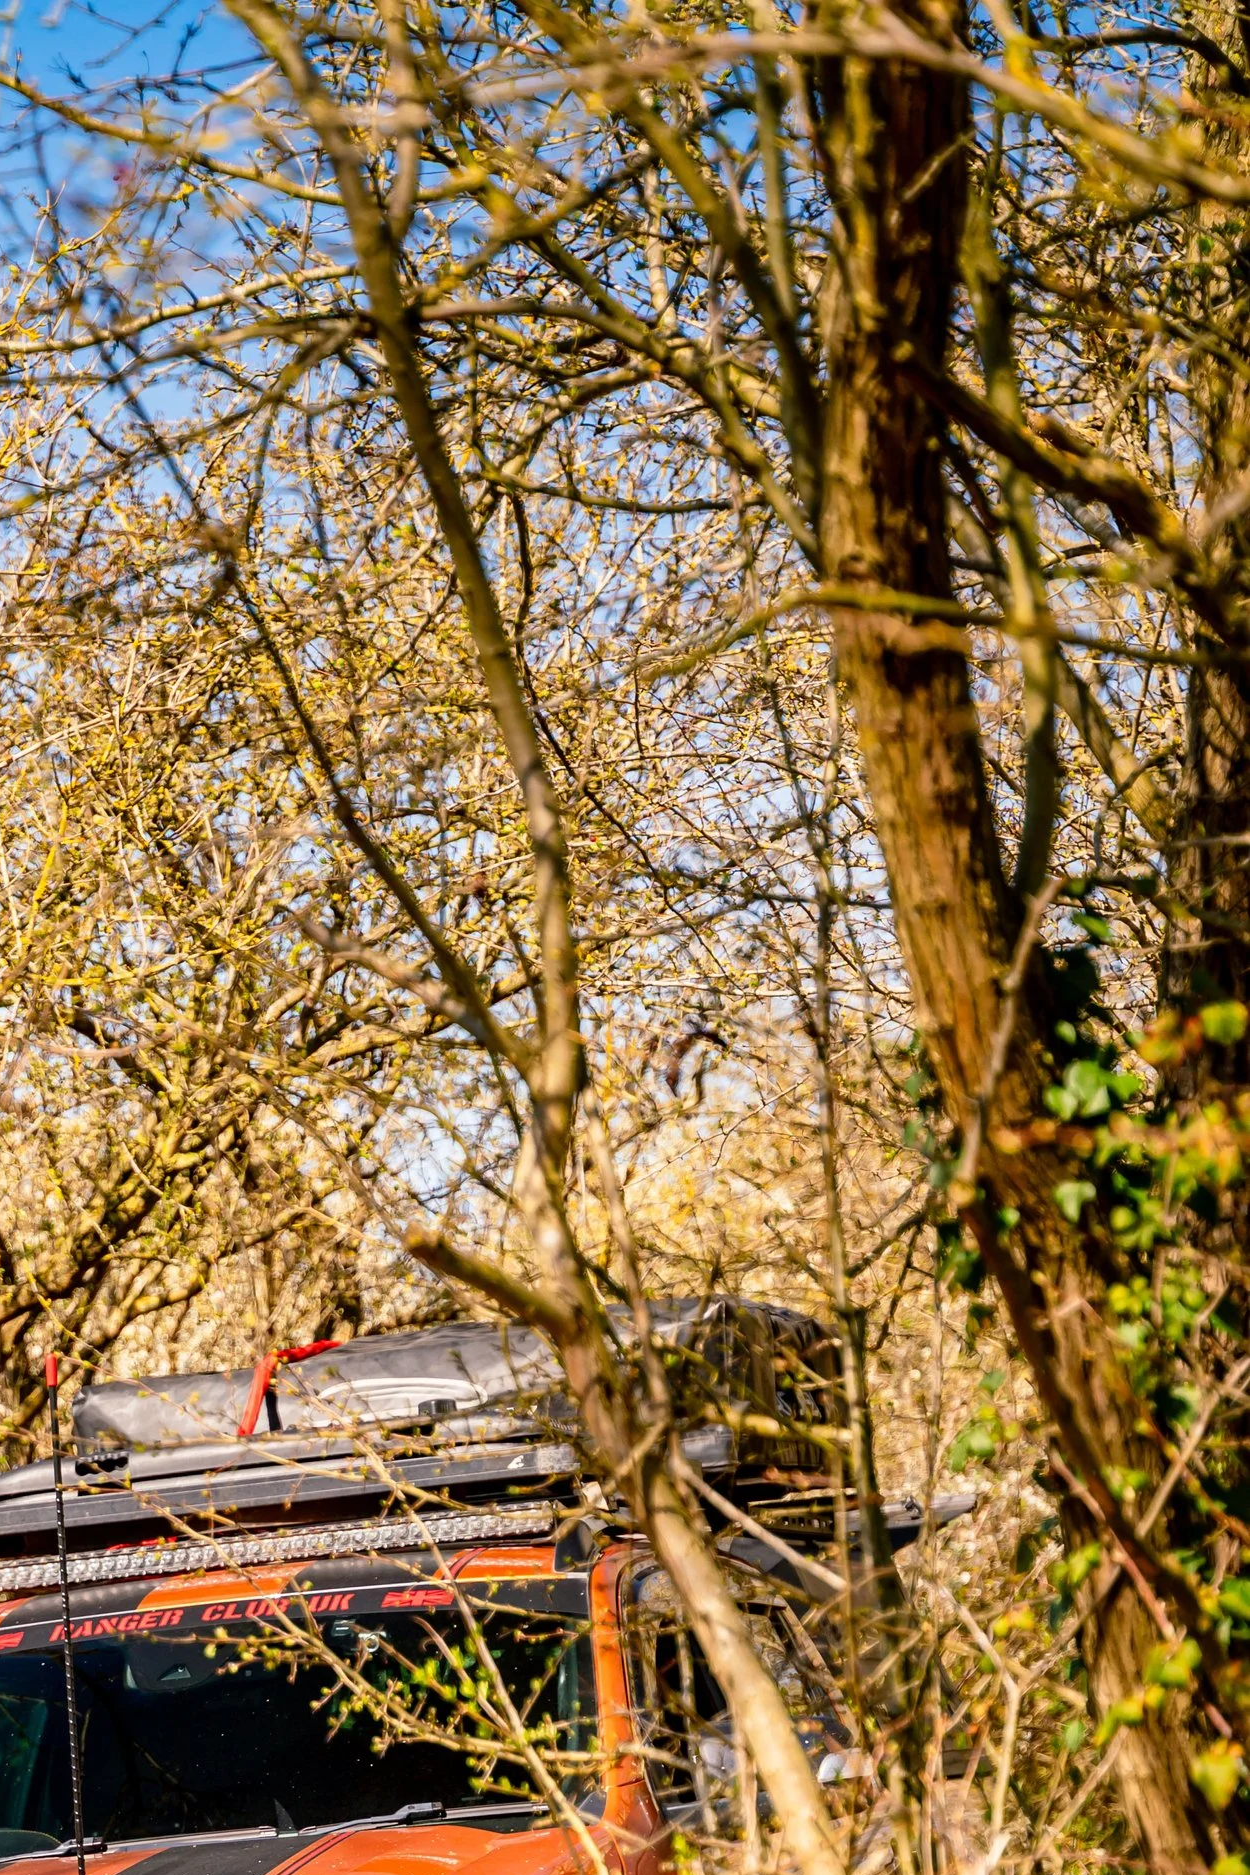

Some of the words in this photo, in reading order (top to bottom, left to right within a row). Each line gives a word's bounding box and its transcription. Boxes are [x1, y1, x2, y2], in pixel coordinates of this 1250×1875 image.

[49, 1609, 184, 1642] RANGER
[201, 1597, 291, 1622] CLUB
[308, 1593, 355, 1613] UK
